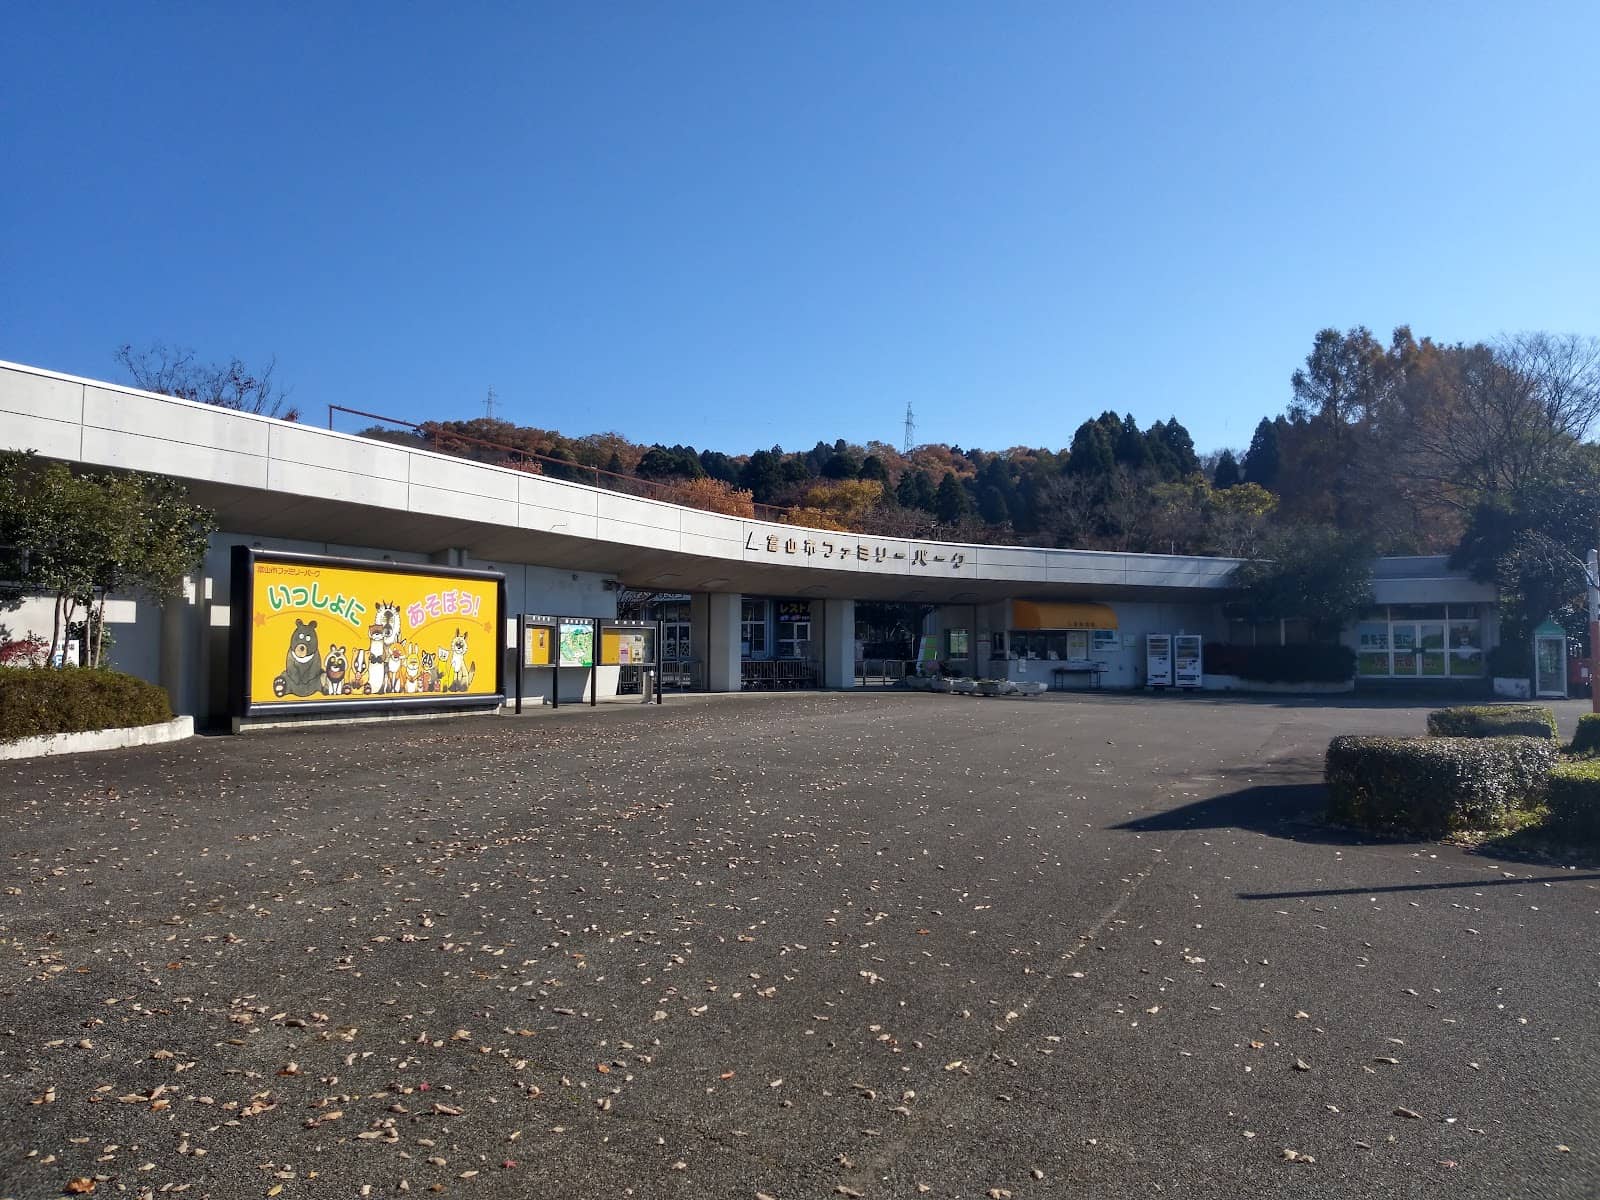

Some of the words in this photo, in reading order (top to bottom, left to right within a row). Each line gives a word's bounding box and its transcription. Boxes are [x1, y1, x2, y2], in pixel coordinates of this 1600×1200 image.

[767, 534, 965, 568] 富山市ファミリーパーク
[268, 582, 367, 627] いっしょに
